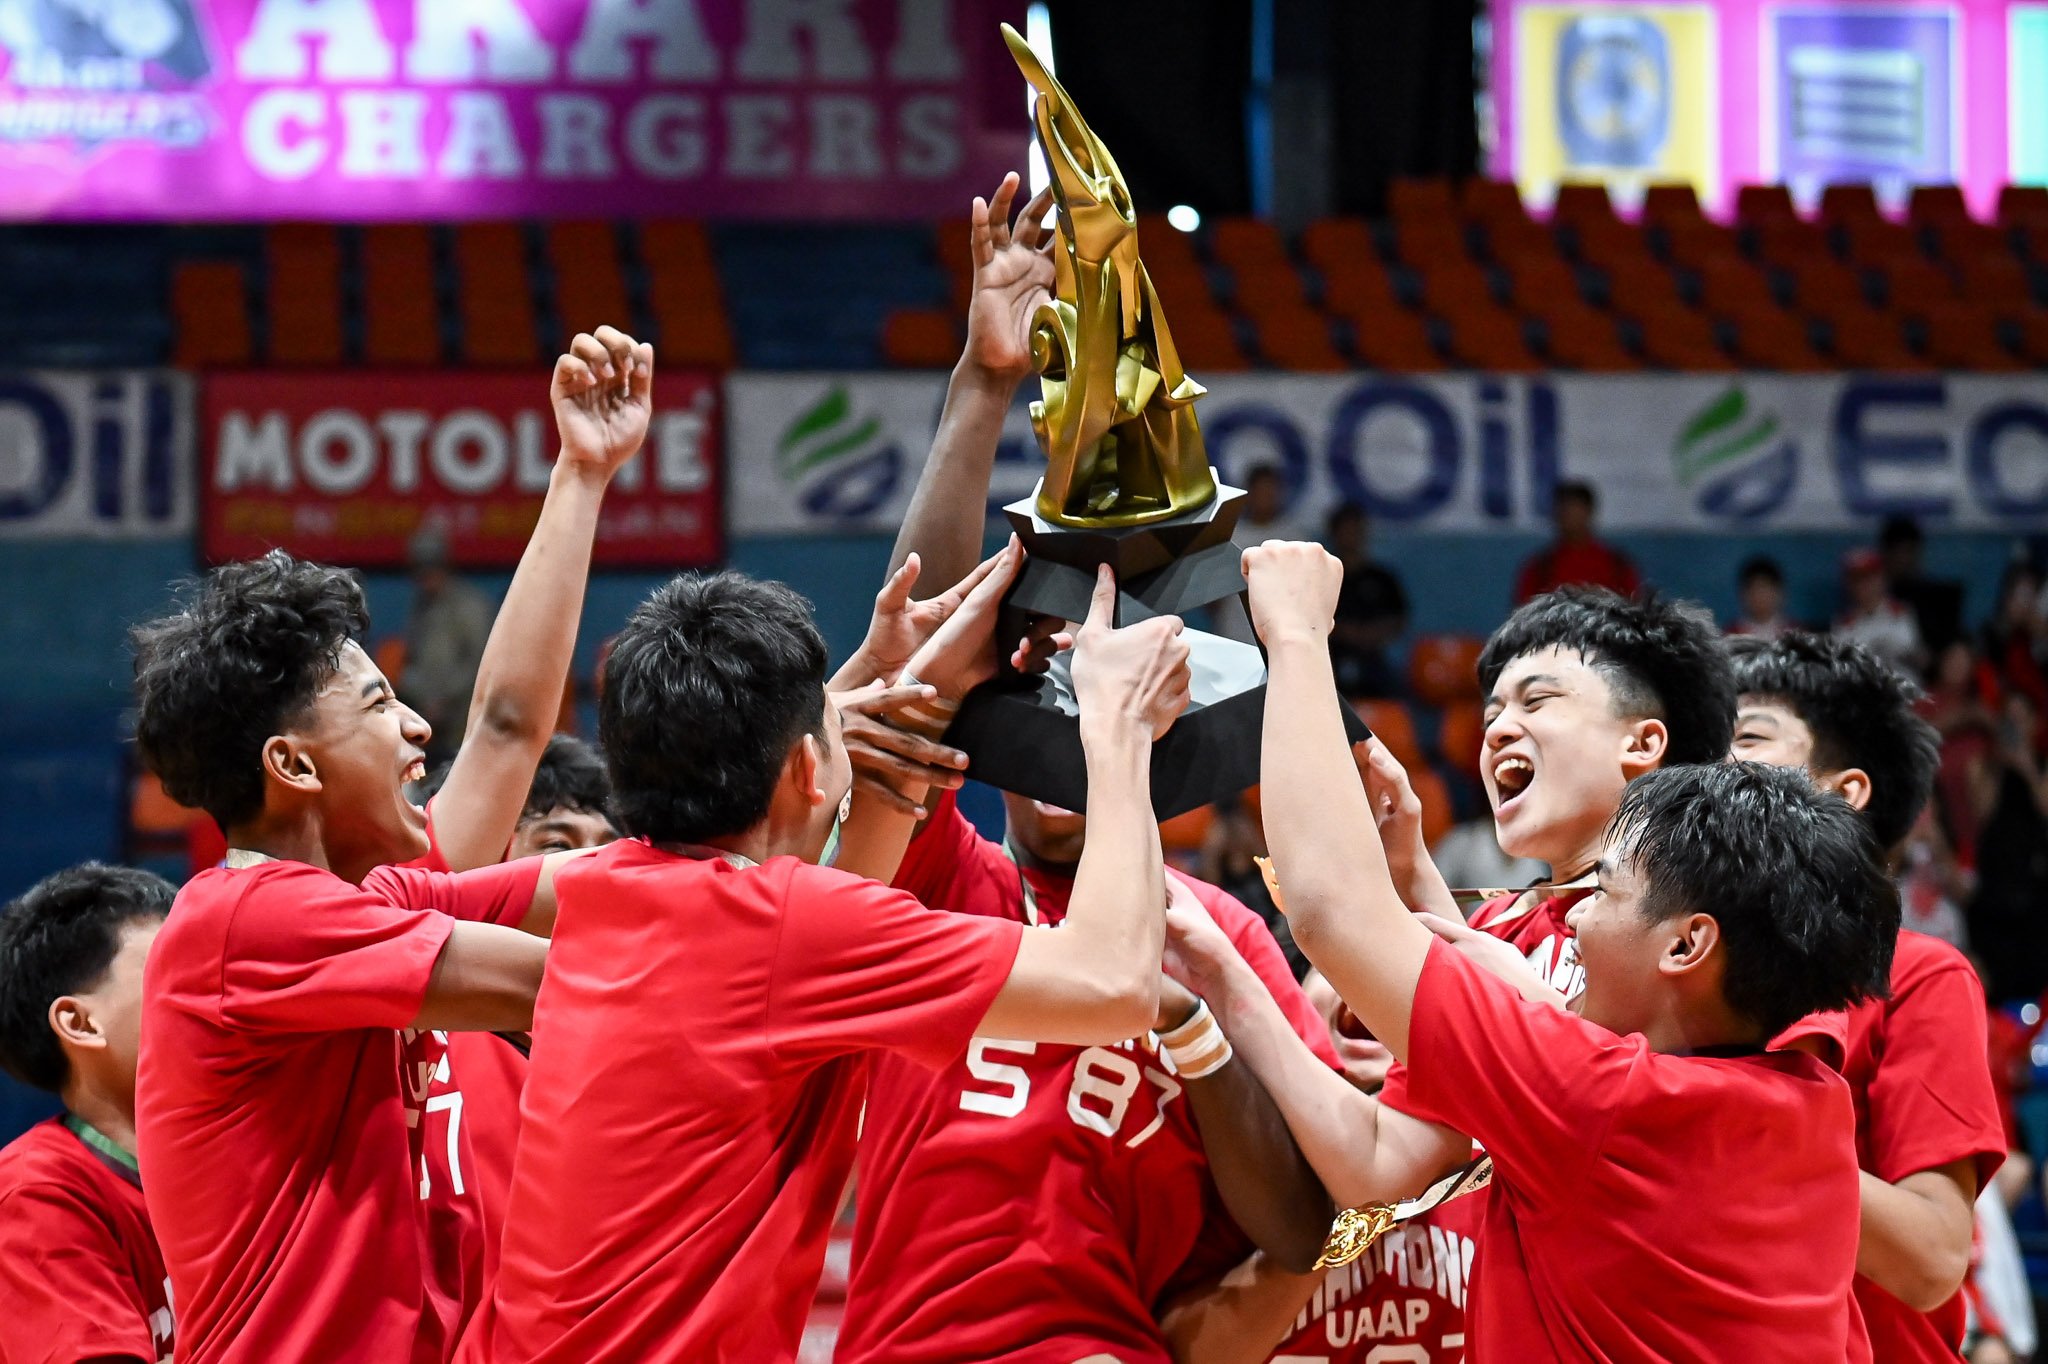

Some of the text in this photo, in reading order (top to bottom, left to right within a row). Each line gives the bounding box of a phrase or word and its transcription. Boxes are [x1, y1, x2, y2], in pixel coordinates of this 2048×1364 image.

[243, 89, 962, 180] CHARGERS
[214, 408, 710, 492] MOTOLE
[1066, 1046, 1182, 1149] 87
[1326, 1298, 1430, 1348] UAAP
